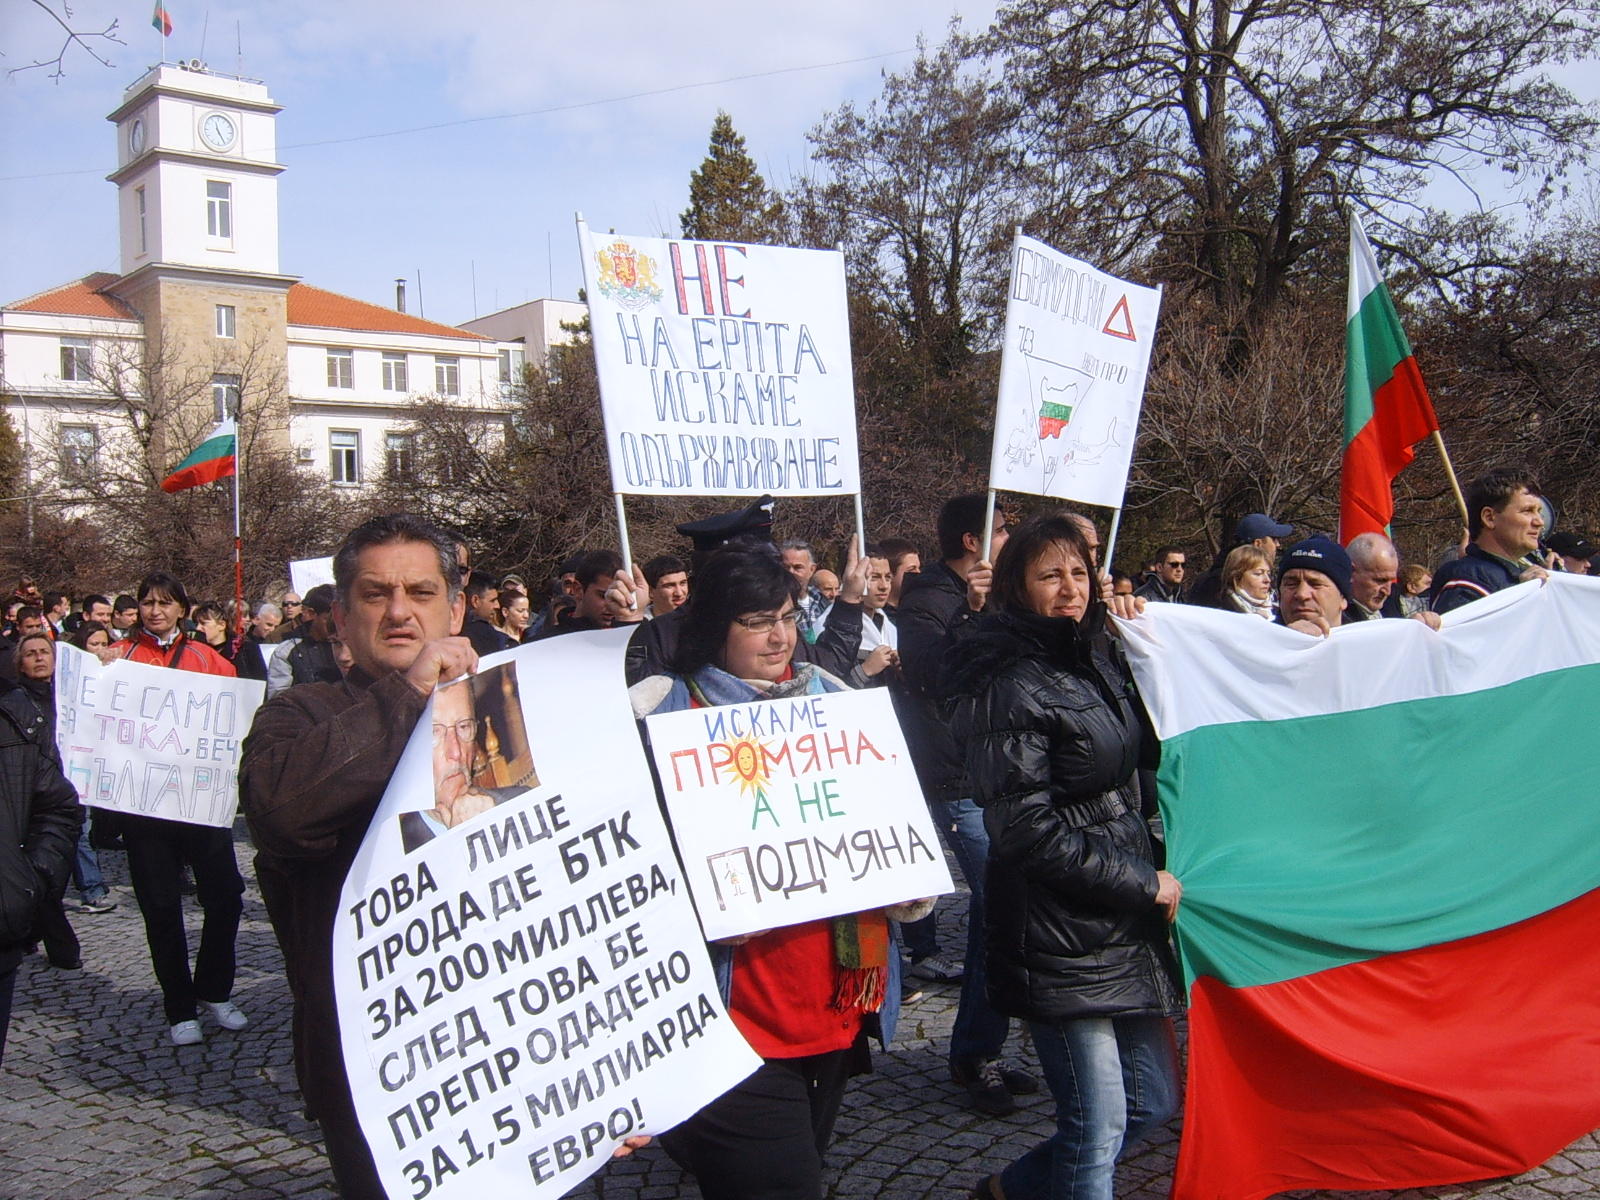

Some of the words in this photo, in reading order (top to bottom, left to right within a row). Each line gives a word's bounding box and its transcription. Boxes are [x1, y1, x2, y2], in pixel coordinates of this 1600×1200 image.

[669, 242, 752, 318] НЕ
[616, 312, 680, 369] НА
[692, 317, 828, 375] ЕРПТА
[650, 368, 802, 427] ИСКАМЕ
[620, 431, 843, 489] ОДЪРЖАВЯВАНЕ
[60, 646, 97, 708] НЕ
[110, 680, 130, 712] Е
[139, 686, 237, 738] САМО
[704, 697, 828, 742] ИСКАМЕ
[669, 728, 898, 792] ПРОМЯНА,
[751, 789, 781, 830] А
[795, 779, 847, 824] НЕ
[350, 861, 439, 941] ТОВА
[465, 793, 571, 873] ЛИЦЕ
[558, 810, 642, 885] БТК
[706, 823, 937, 912] ПОДМЯНА
[366, 984, 419, 1041] ЗА
[416, 942, 490, 1008] 200
[378, 1005, 492, 1094] СЛЕД
[493, 955, 600, 1028] ТОВА
[605, 922, 649, 971] БЕ
[386, 949, 692, 1152] ПРЕПРОДАДЕНО
[401, 1144, 461, 1200] ЗА
[457, 1104, 522, 1168] 1,5
[525, 992, 719, 1129] МИЛИАРДА
[528, 1097, 646, 1186] ЕВРО!
